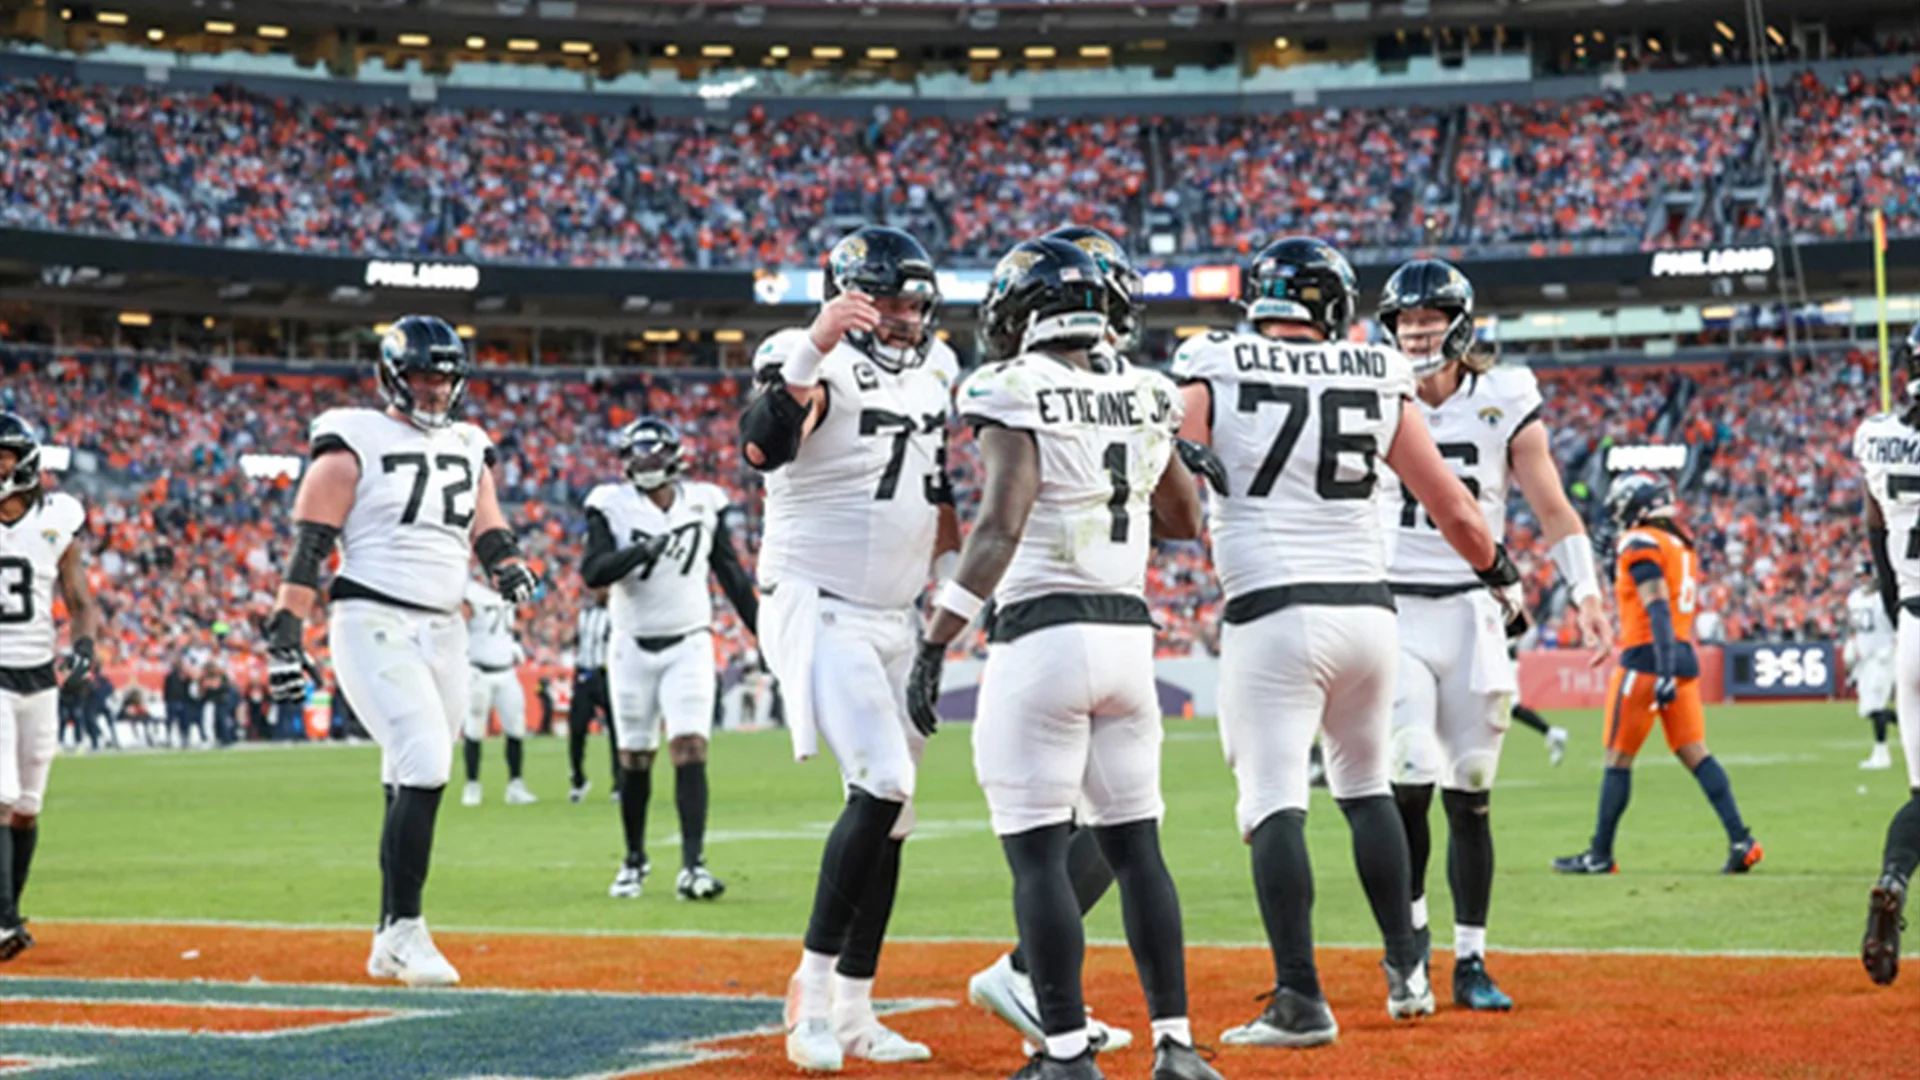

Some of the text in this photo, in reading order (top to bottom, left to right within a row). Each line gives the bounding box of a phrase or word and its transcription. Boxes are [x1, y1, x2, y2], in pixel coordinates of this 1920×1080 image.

[1234, 343, 1387, 378] CLEVELAND
[1238, 381, 1381, 500] 76
[382, 452, 475, 529] 72
[1103, 442, 1130, 543] 1
